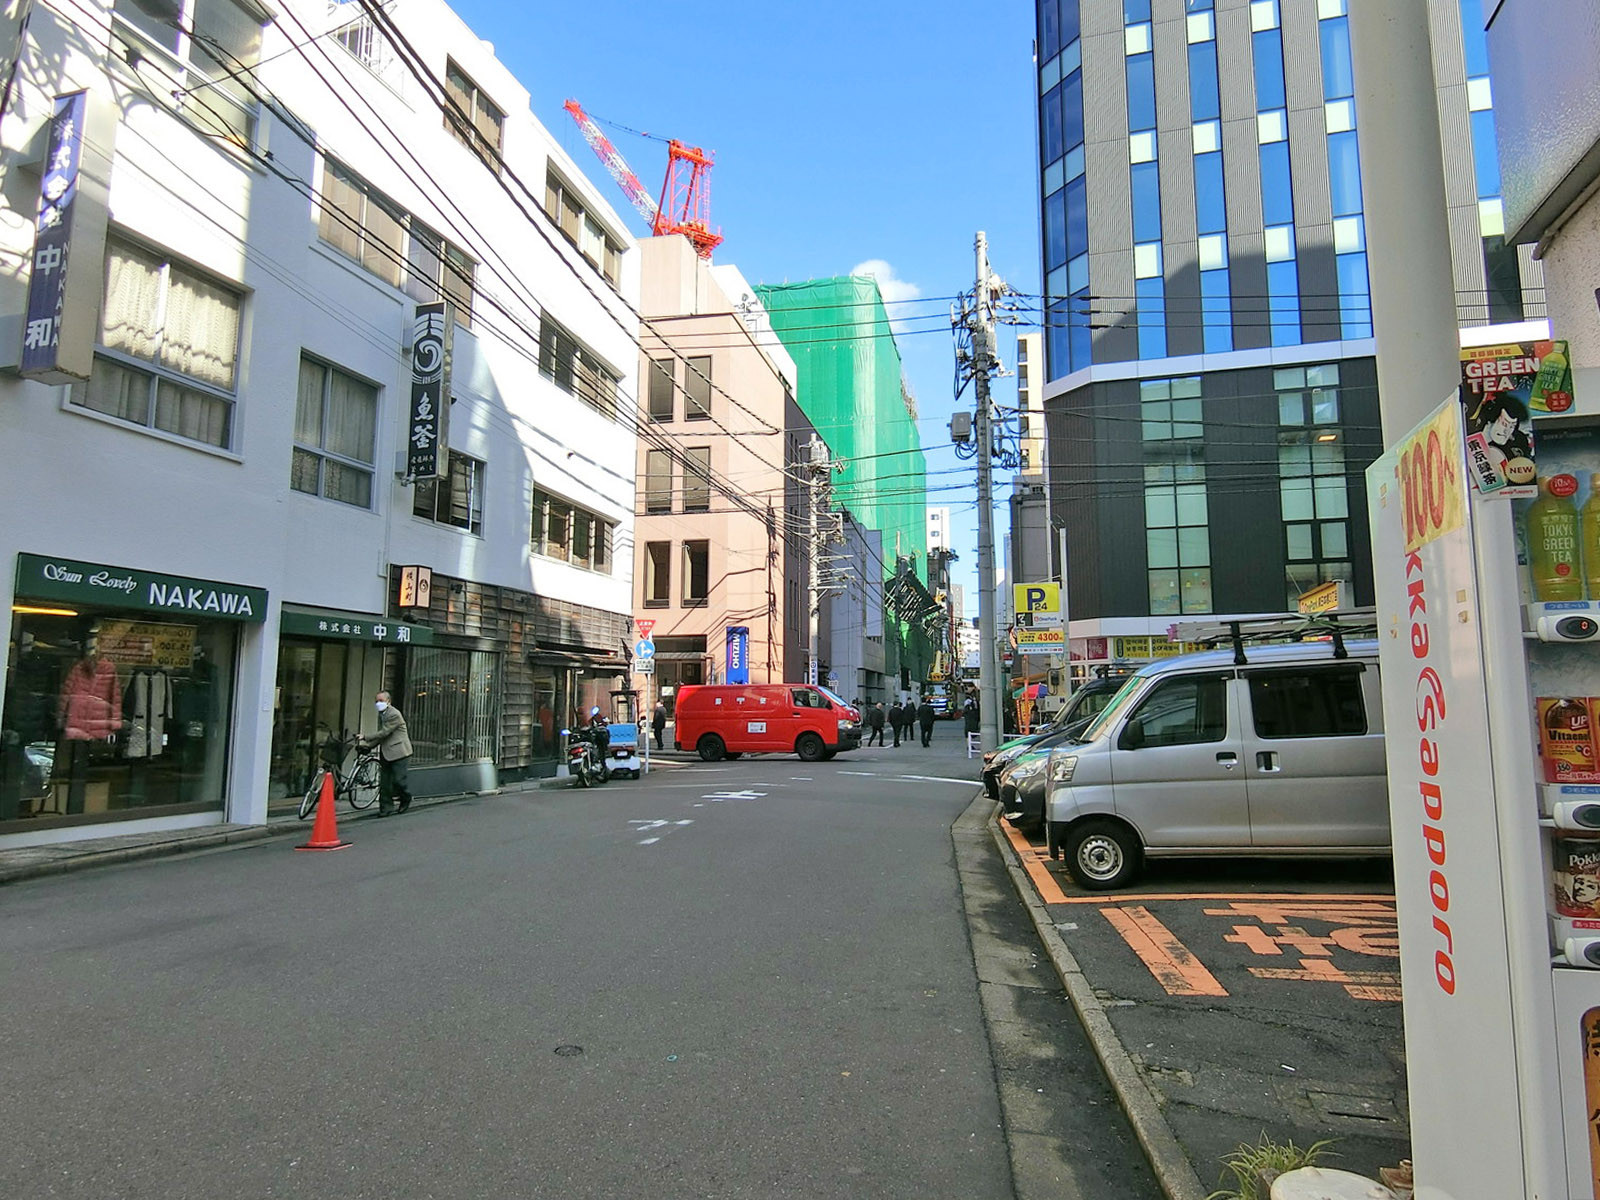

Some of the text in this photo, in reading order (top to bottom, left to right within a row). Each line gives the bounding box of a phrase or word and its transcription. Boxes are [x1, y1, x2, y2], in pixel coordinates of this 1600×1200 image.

[51, 242, 71, 348] NAKAWA
[1466, 357, 1540, 378] GREEN
[1467, 376, 1515, 393] TEA
[411, 391, 437, 449] 魚釜
[1509, 466, 1532, 474] NEW
[1551, 551, 1573, 563] TEA
[43, 563, 253, 616] Sun Lovely NAKAWA
[1027, 588, 1046, 611] P
[1034, 602, 1048, 611] 24
[319, 620, 412, 643] 株式会社 中和
[732, 633, 740, 669] MIZUHO
[1571, 715, 1588, 727] UP
